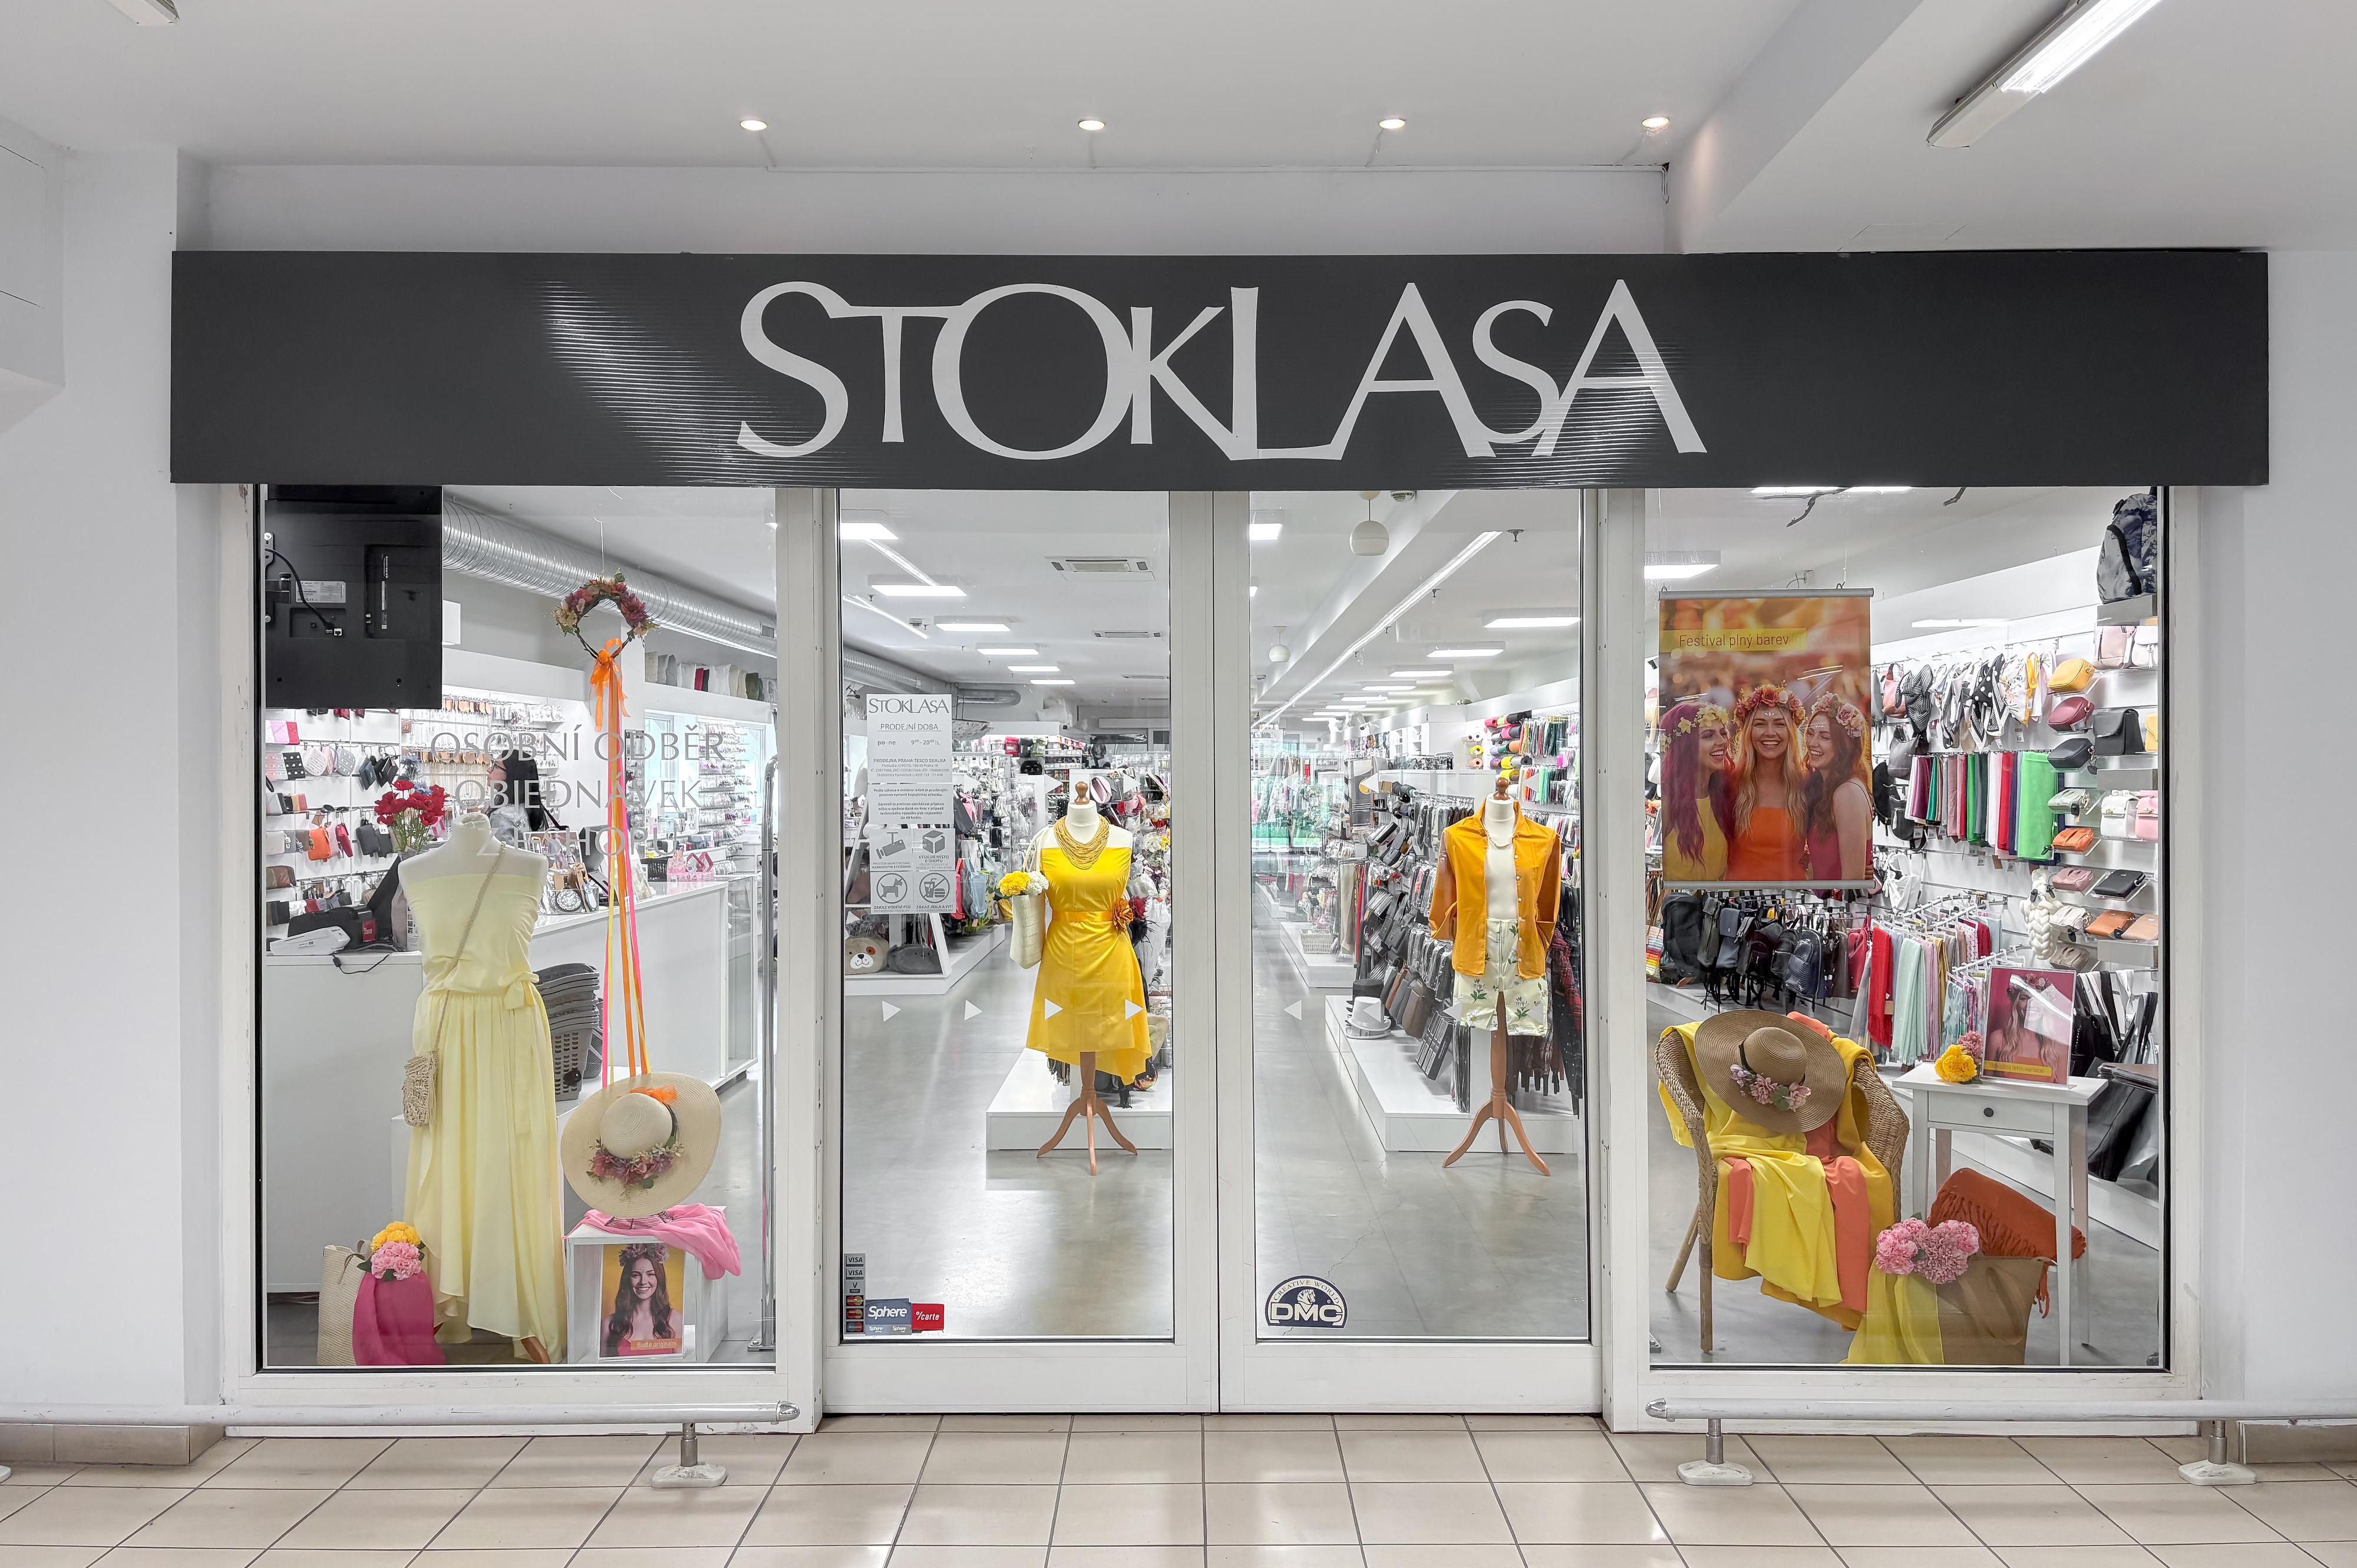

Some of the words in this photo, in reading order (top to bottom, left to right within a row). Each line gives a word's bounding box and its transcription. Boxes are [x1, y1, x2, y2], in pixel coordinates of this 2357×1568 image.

[737, 279, 1707, 461] STOKLASA
[1679, 633, 1725, 647] Festival
[1729, 633, 1753, 648] plný
[1756, 634, 1789, 646] barev
[869, 698, 950, 714] STOKLASA
[431, 724, 582, 762] OSOBNÍ
[594, 724, 726, 762] ODBĚR
[455, 773, 701, 814] OBJEDNÁVEK
[476, 827, 499, 856] Z
[1273, 1280, 1311, 1300] CREATIVE
[1314, 1280, 1339, 1303] WORLD
[867, 1306, 907, 1319] Sphere
[1271, 1303, 1343, 1322] DMC
